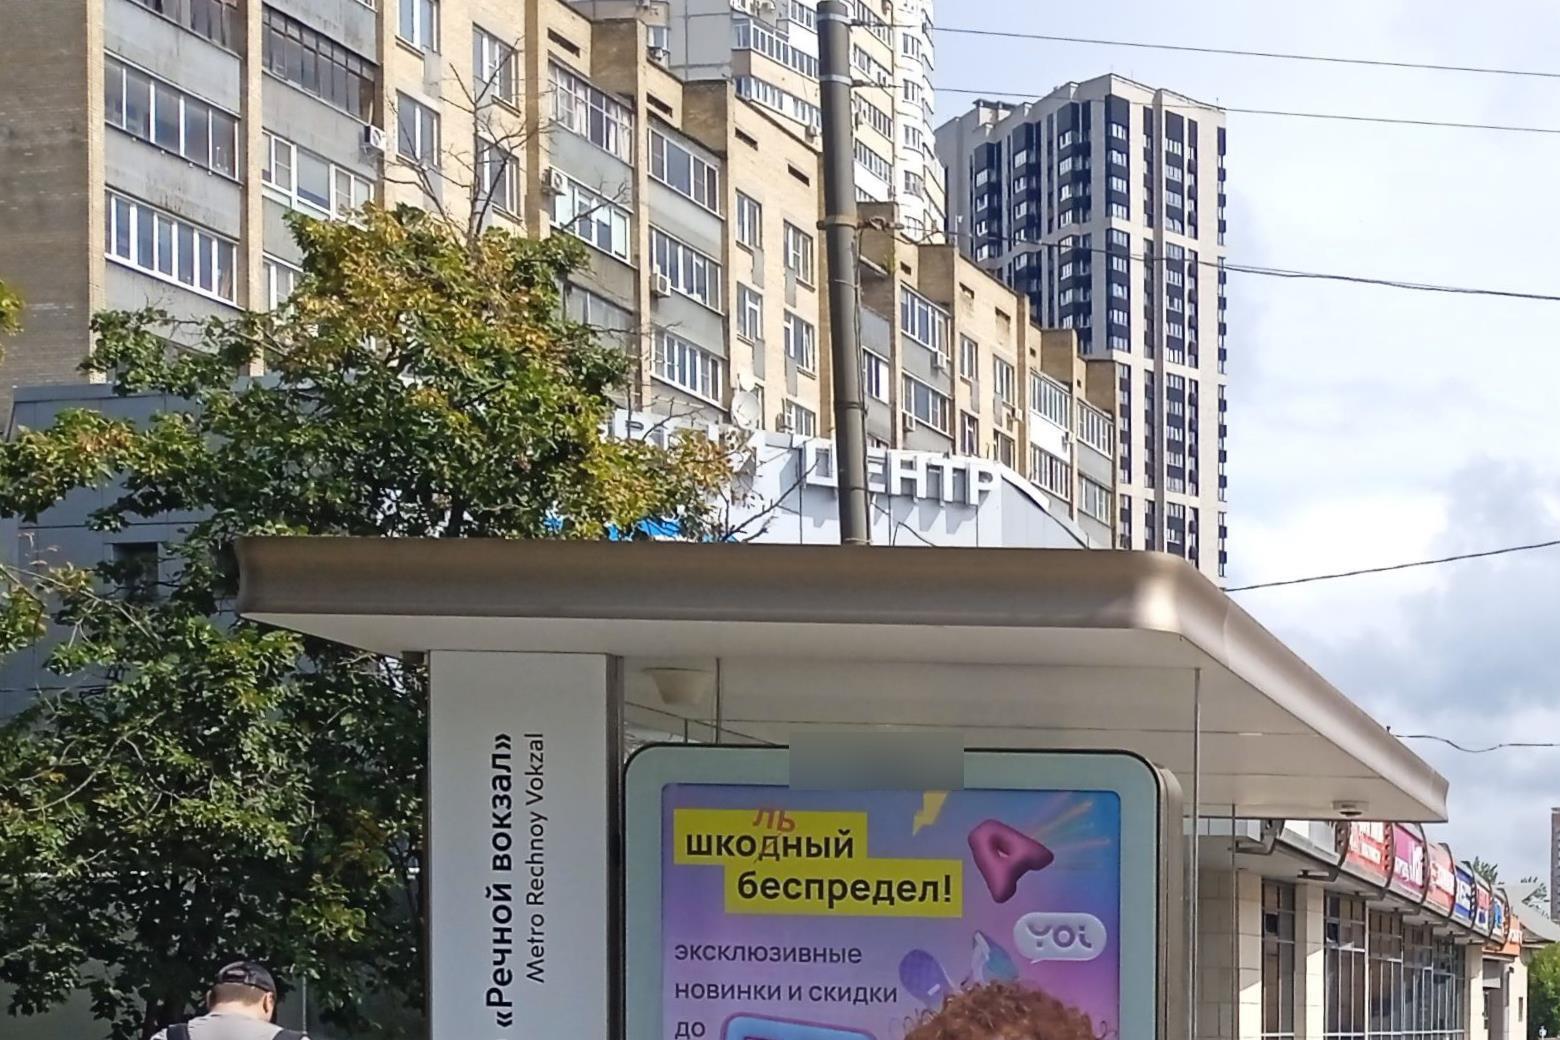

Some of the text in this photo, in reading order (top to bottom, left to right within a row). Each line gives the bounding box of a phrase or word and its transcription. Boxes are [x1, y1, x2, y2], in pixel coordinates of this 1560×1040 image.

[491, 733, 512, 871] вокзал»
[524, 734, 548, 983] Metro Rechnoy Vokzal
[686, 829, 854, 862] шкодный
[738, 871, 952, 909] беспредел!
[485, 883, 512, 1027] «Речной
[674, 944, 862, 963] эксклюзивные
[675, 983, 898, 1005] новинки и скидки
[675, 1021, 706, 1040] до
